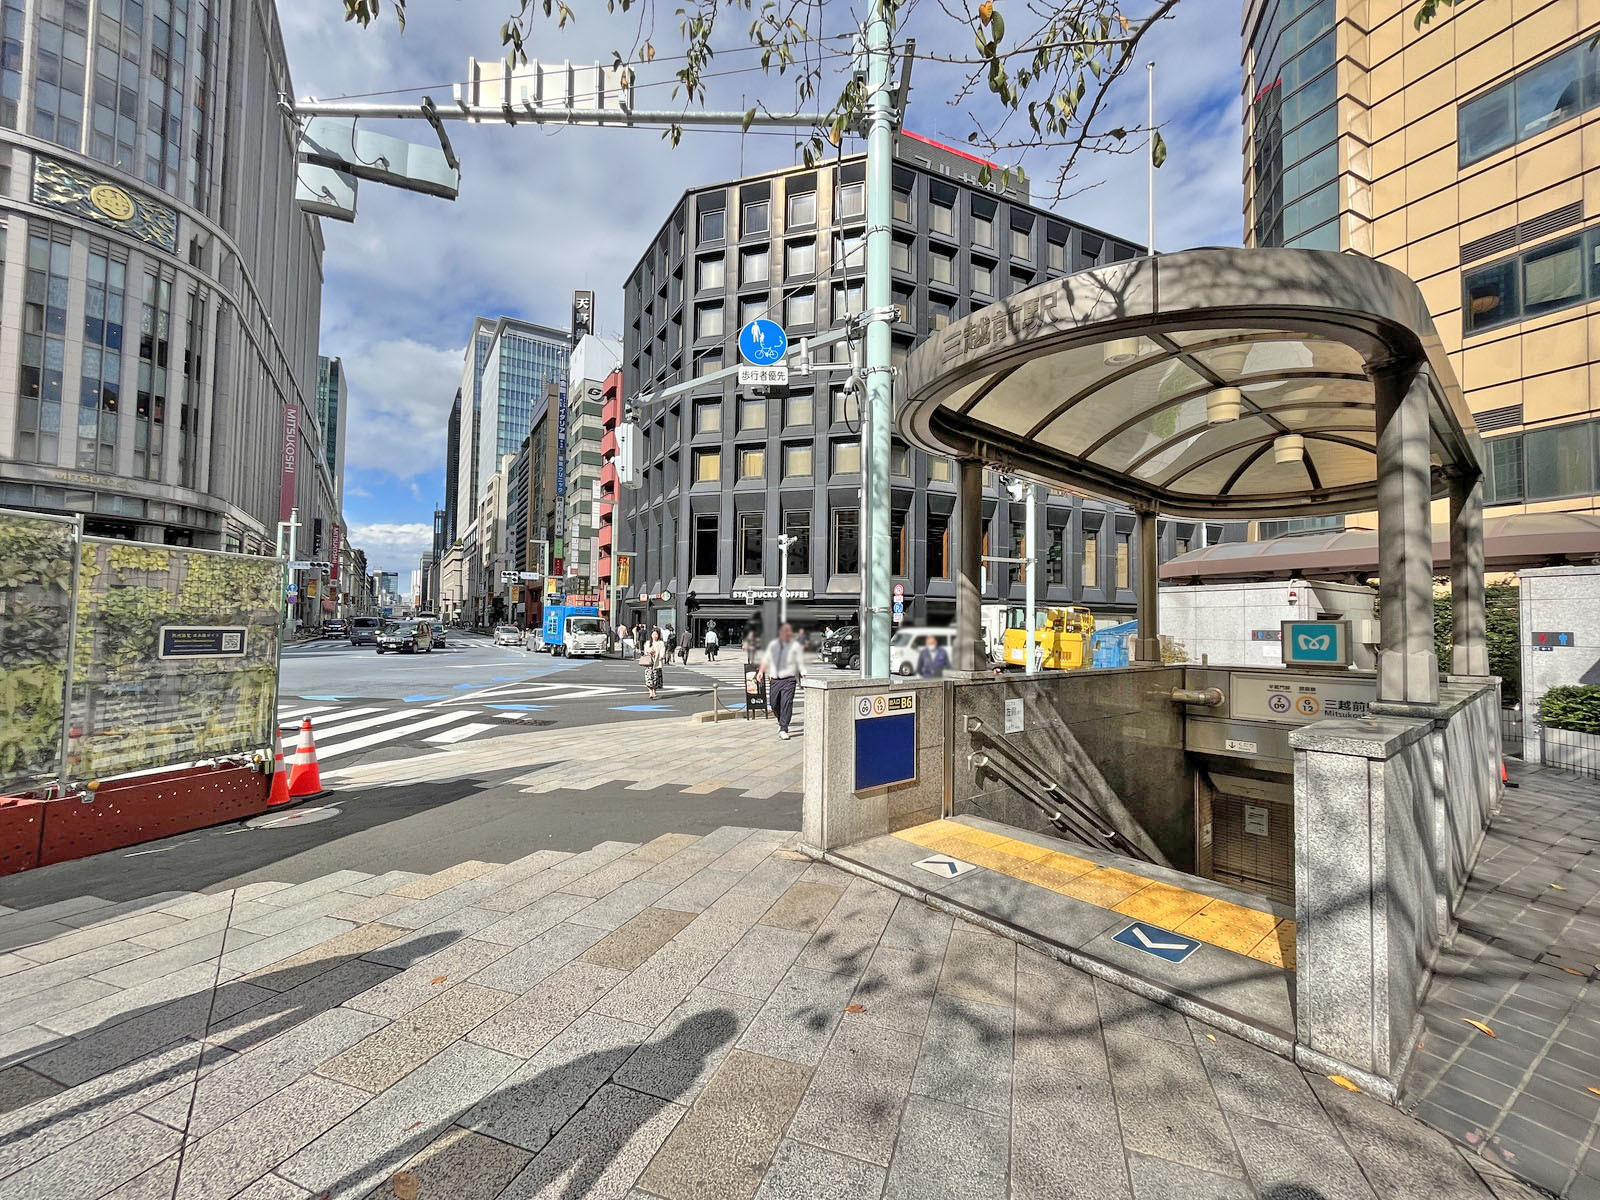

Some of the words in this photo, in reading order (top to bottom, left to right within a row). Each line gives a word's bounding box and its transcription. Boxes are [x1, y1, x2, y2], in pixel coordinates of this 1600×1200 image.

[943, 292, 1058, 365] 三越前駅
[742, 371, 785, 381] 歩行者優先
[285, 408, 297, 474] MITSUKOSHI
[901, 696, 912, 709] B6
[1324, 699, 1370, 712] 三越前
